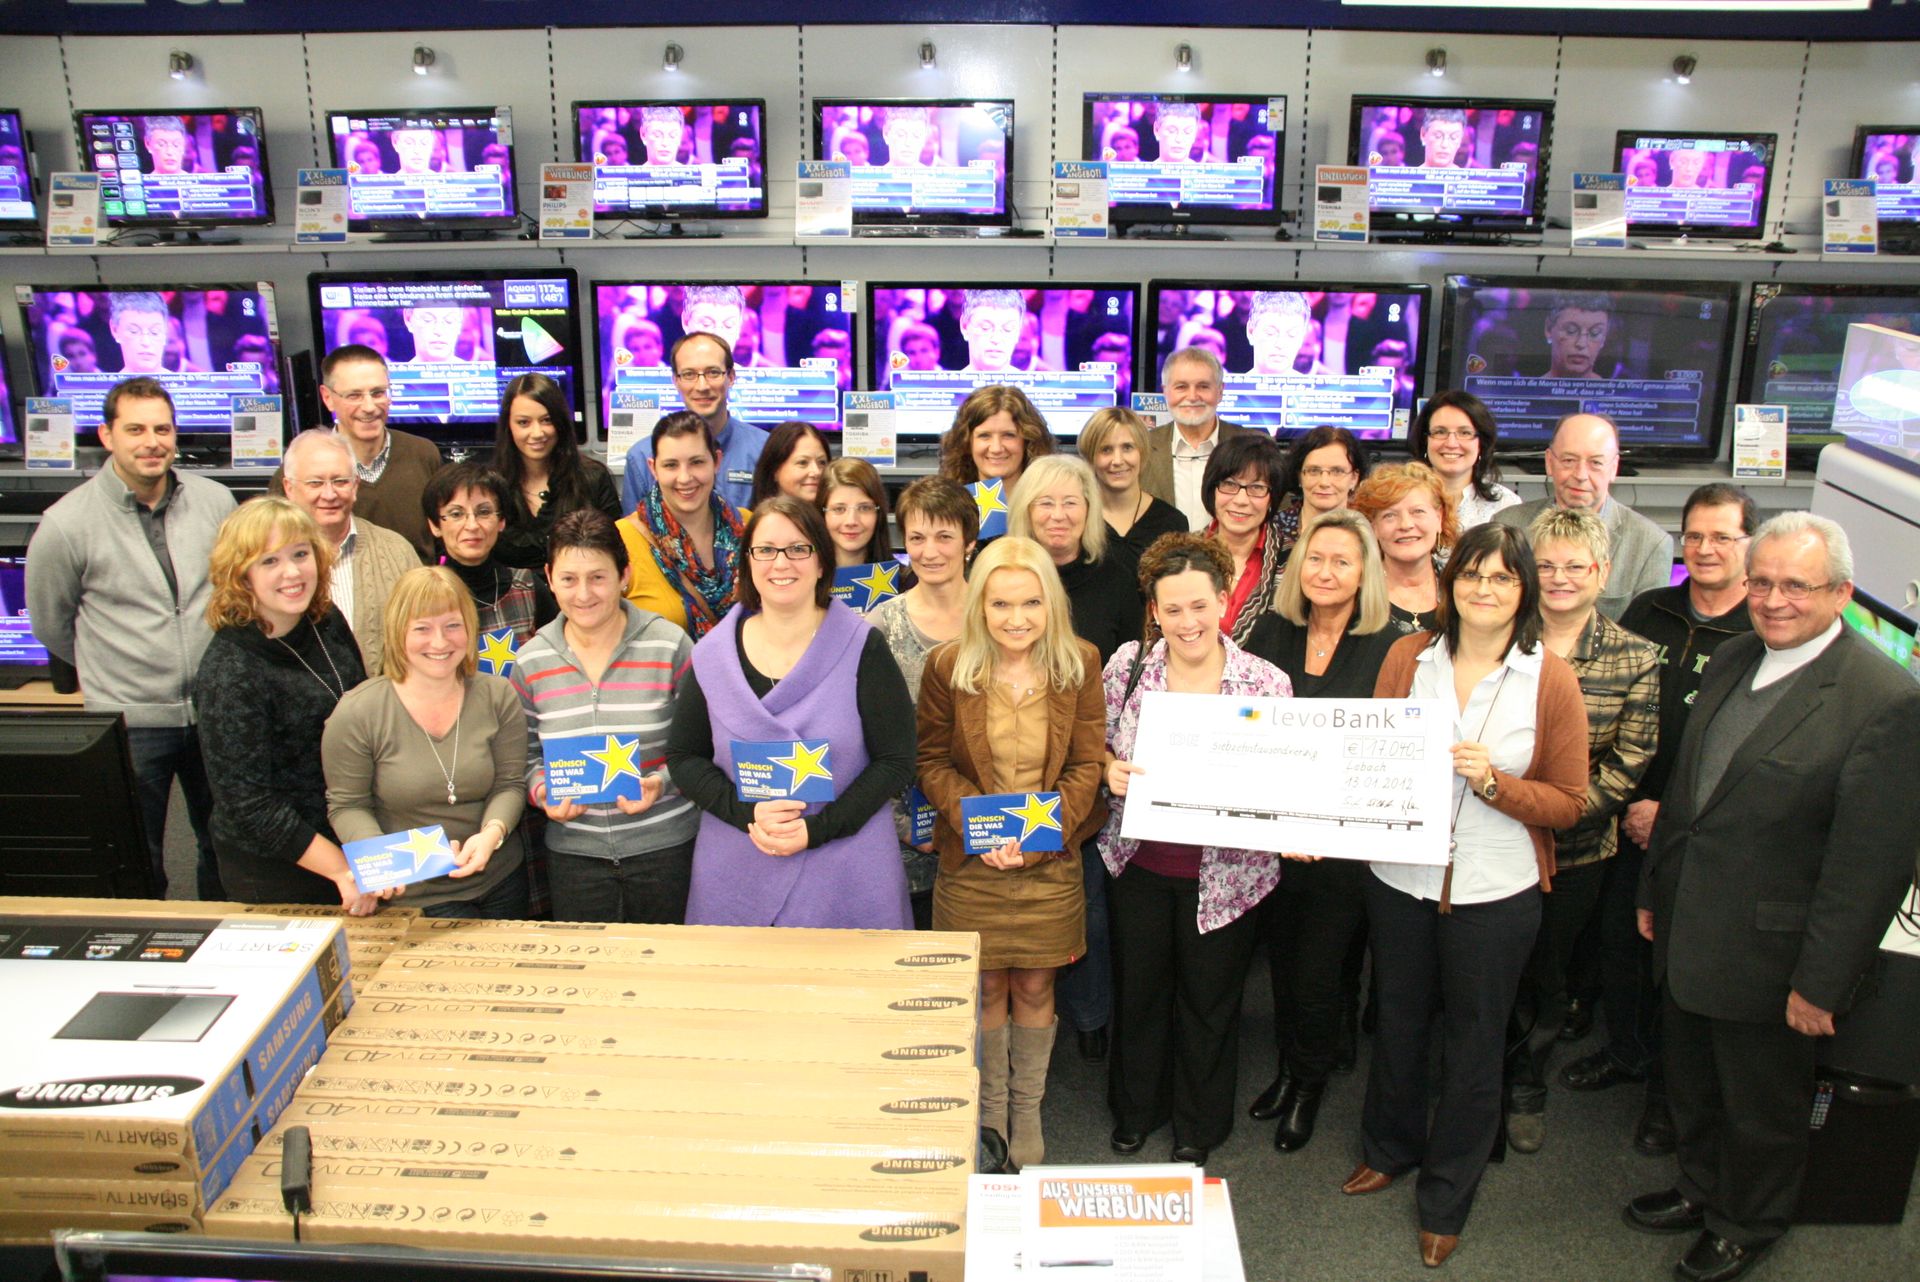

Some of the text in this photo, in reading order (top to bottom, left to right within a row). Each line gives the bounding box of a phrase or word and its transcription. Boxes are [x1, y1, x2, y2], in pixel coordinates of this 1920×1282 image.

[1476, 378, 1496, 386] Wenn
[1513, 379, 1526, 387] sich
[1527, 379, 1538, 387] die
[1272, 706, 1396, 729] levoBank
[549, 759, 587, 769] WÜNSCH
[737, 761, 774, 772] WÜNSCH
[550, 768, 585, 777] DIR WAS
[739, 770, 772, 779] DIR WAS
[550, 777, 570, 785] VON
[740, 777, 759, 786] VON
[916, 812, 930, 820] DIR
[968, 815, 1006, 823] WÜNSCH
[916, 819, 932, 827] VON
[968, 822, 1004, 831] DIR WAS
[969, 830, 989, 838] VON
[401, 958, 444, 969] 40
[903, 956, 962, 964] SAMSUNG
[371, 1000, 417, 1013] 40
[897, 999, 959, 1008] SAMSUNG
[257, 991, 312, 1072] SAMSUNG
[344, 1049, 392, 1062] 40
[891, 1047, 956, 1057] SAMSUNG
[15, 1082, 175, 1101] SAMSUNG
[305, 1100, 356, 1116] 40
[889, 1100, 958, 1110] SAMSUNG
[882, 1159, 955, 1170] SAMSUNG
[1041, 1180, 1134, 1199] AUS UNSERER
[1056, 1191, 1193, 1223] WERBUNG!
[871, 1224, 948, 1237] SAMSUNG
